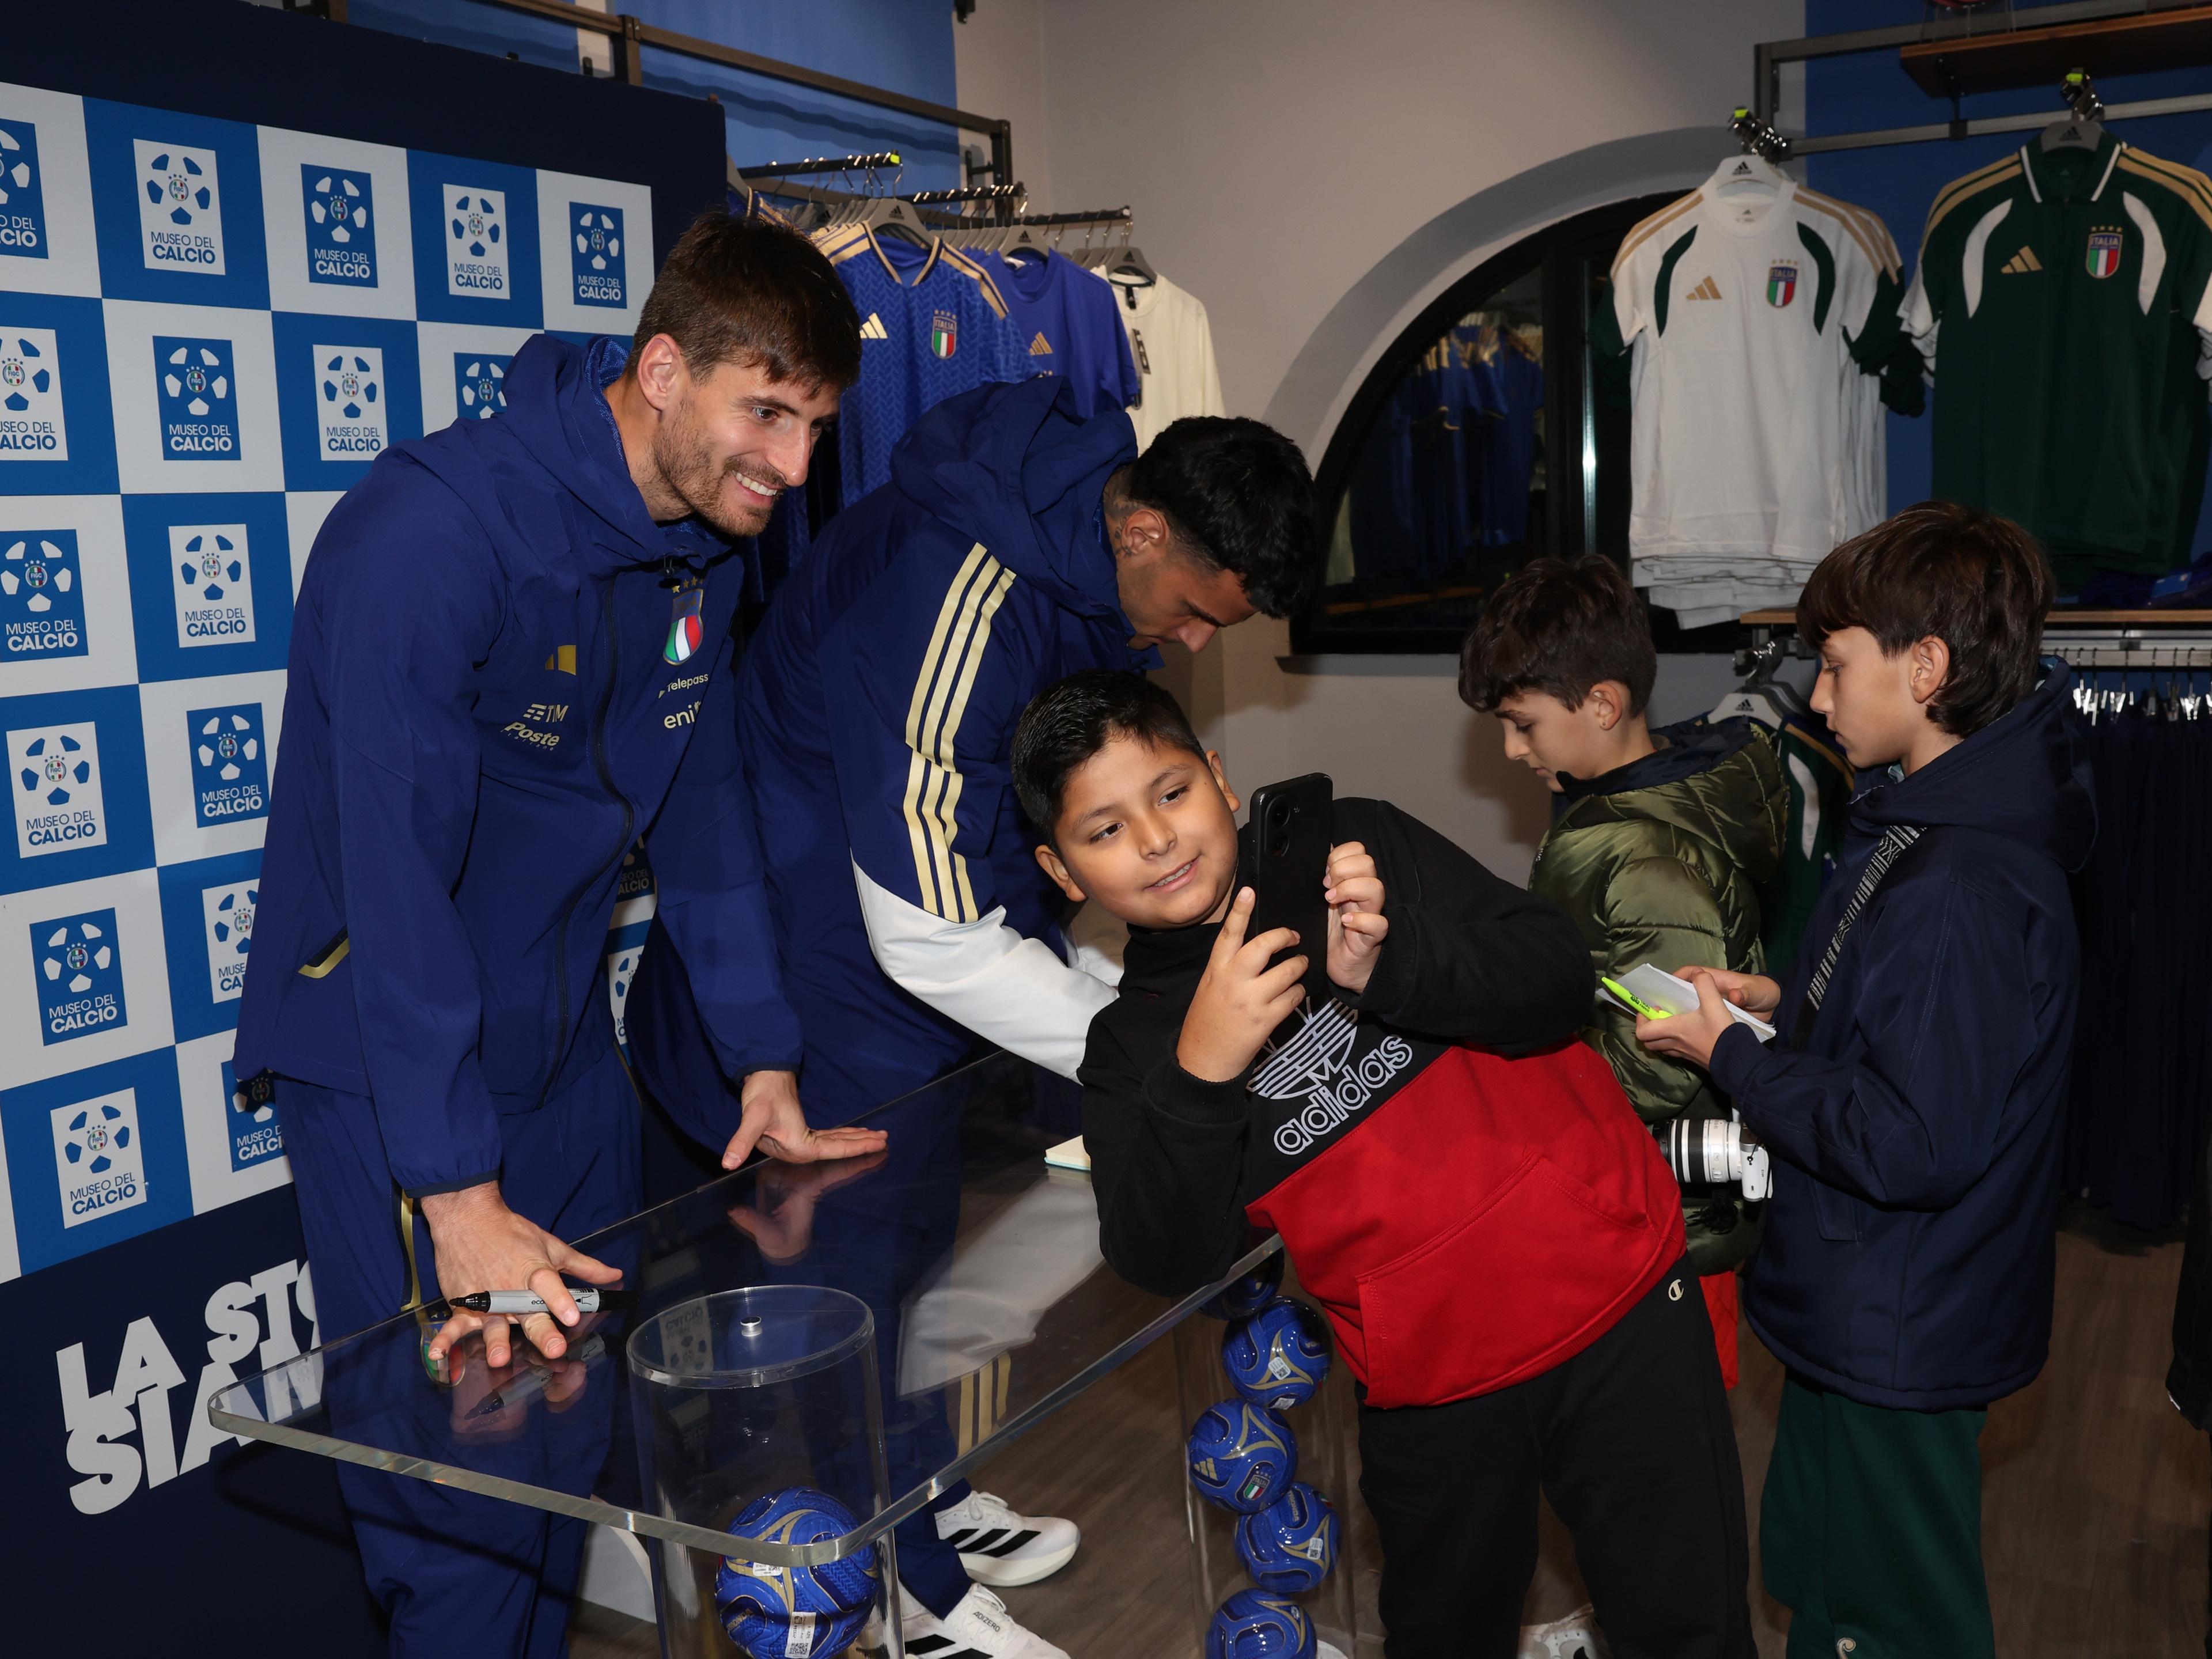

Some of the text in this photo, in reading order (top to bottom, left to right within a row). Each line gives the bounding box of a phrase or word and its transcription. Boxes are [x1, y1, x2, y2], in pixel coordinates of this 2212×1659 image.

[12, 216, 36, 230] DEL
[0, 230, 37, 247] CIO
[151, 232, 215, 248] MUSEO DEL
[153, 244, 215, 264] CALCIO
[315, 248, 369, 264] MUSEO DEL
[315, 260, 370, 279] CALCIO
[454, 263, 502, 276] MUSEO DEL
[455, 274, 503, 290] CALCIO
[578, 275, 621, 288] MUSEO DEL
[579, 287, 622, 301] CALCIO
[33, 422, 55, 433] DEL
[169, 424, 231, 435] MUSEO DEL
[327, 427, 380, 437] MUSEO DEL
[171, 437, 232, 452] CALCIO
[328, 438, 381, 452] CALCIO
[185, 608, 245, 622] MUSEO DEL
[6, 619, 77, 635] MUSEO DEL
[187, 619, 246, 637] CALCIO
[7, 632, 78, 652] CALCIO
[666, 673, 709, 692] Telepass
[546, 704, 569, 722] TIM
[664, 704, 695, 729] eni
[505, 722, 560, 746] Poste
[202, 785, 262, 803] MUSEO DEL
[204, 796, 263, 817] CALCIO
[26, 810, 95, 831] MUSEO DEL
[28, 823, 96, 846] CALCIO
[49, 994, 116, 1019] MUSEO DEL
[51, 1006, 118, 1033] CALCIO
[1274, 1035, 1412, 1156] adidas
[236, 1128, 272, 1148] MUSEO
[238, 1135, 285, 1161] CALCI
[70, 1172, 135, 1201] MUSEO DEL
[72, 1184, 137, 1215] CALCIO
[56, 1316, 187, 1433] LA
[972, 1611, 1001, 1633] ADIZERO
